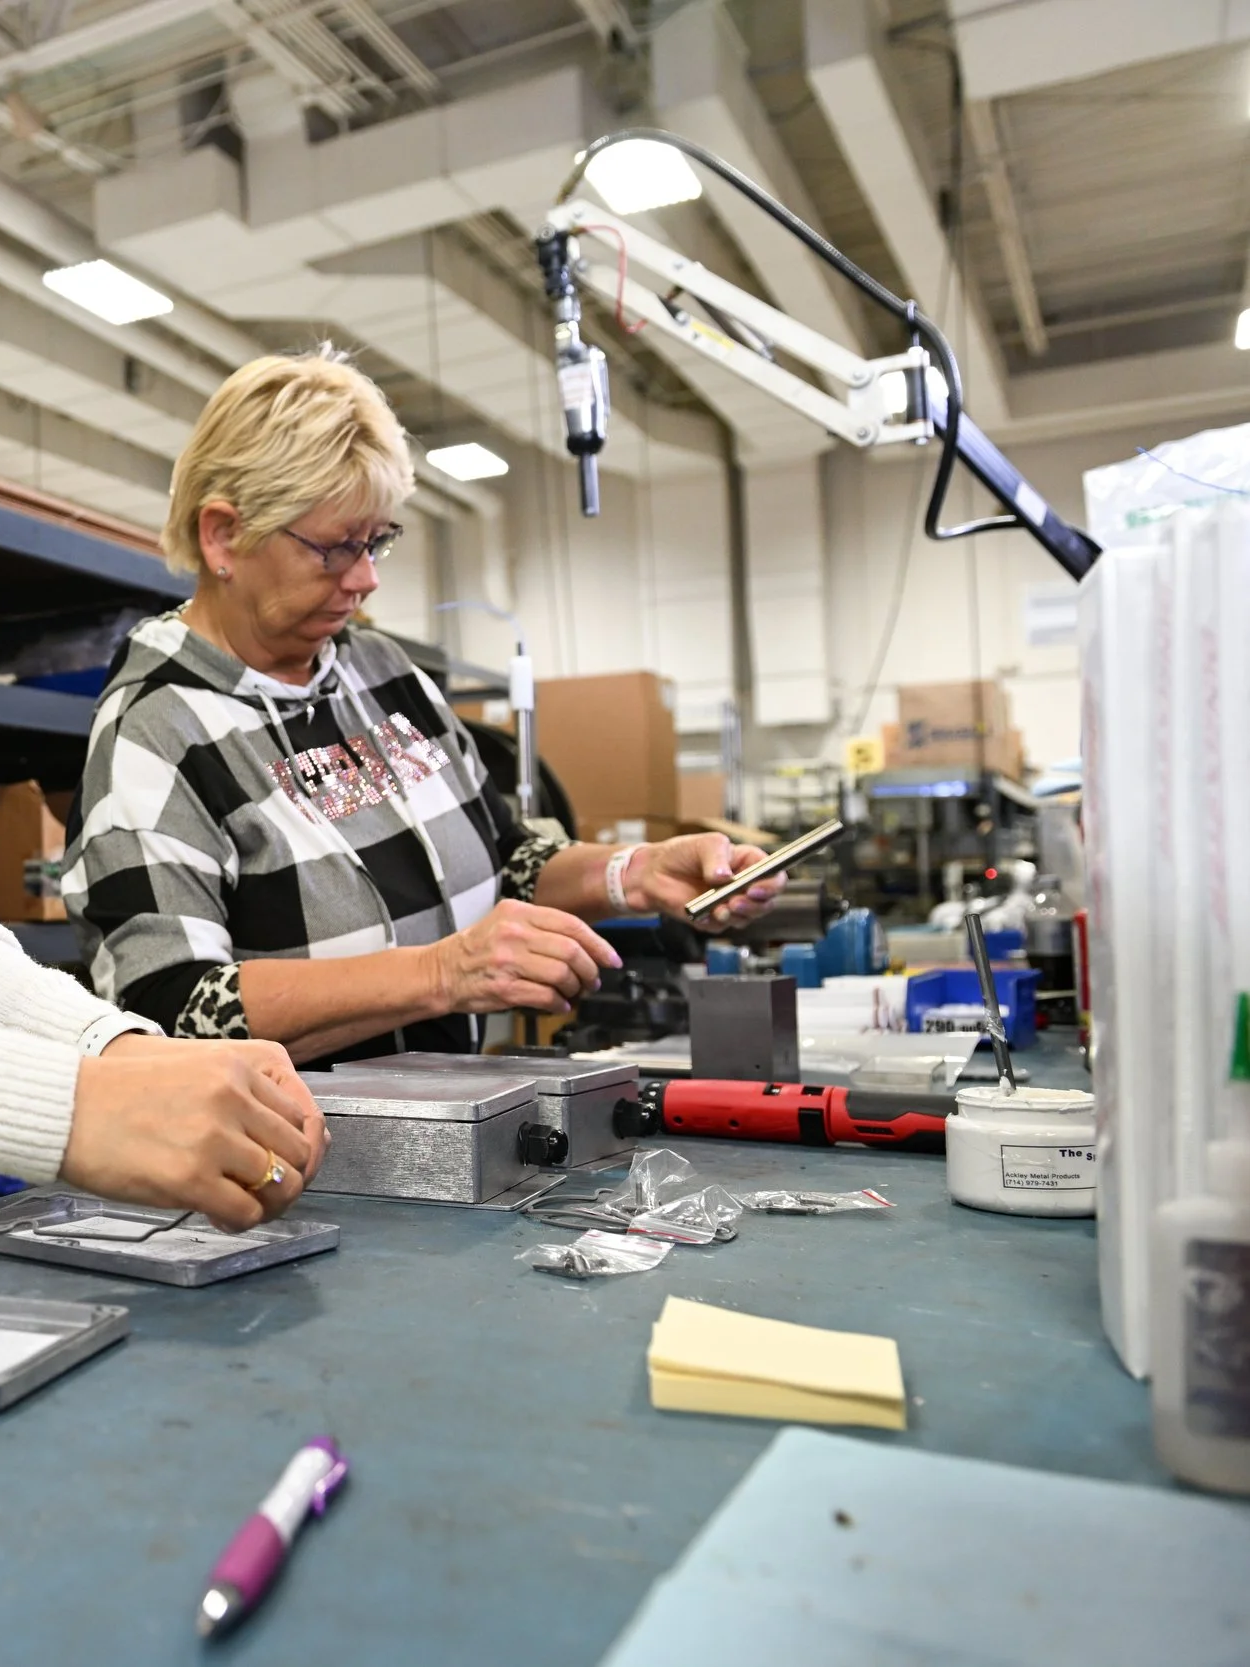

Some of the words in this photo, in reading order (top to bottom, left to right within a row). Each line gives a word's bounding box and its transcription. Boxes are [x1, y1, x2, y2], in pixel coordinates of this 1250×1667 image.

[1058, 1148, 1083, 1158] The
[1005, 1172, 1028, 1180] Ackley
[1005, 1179, 1024, 1187] (714)
